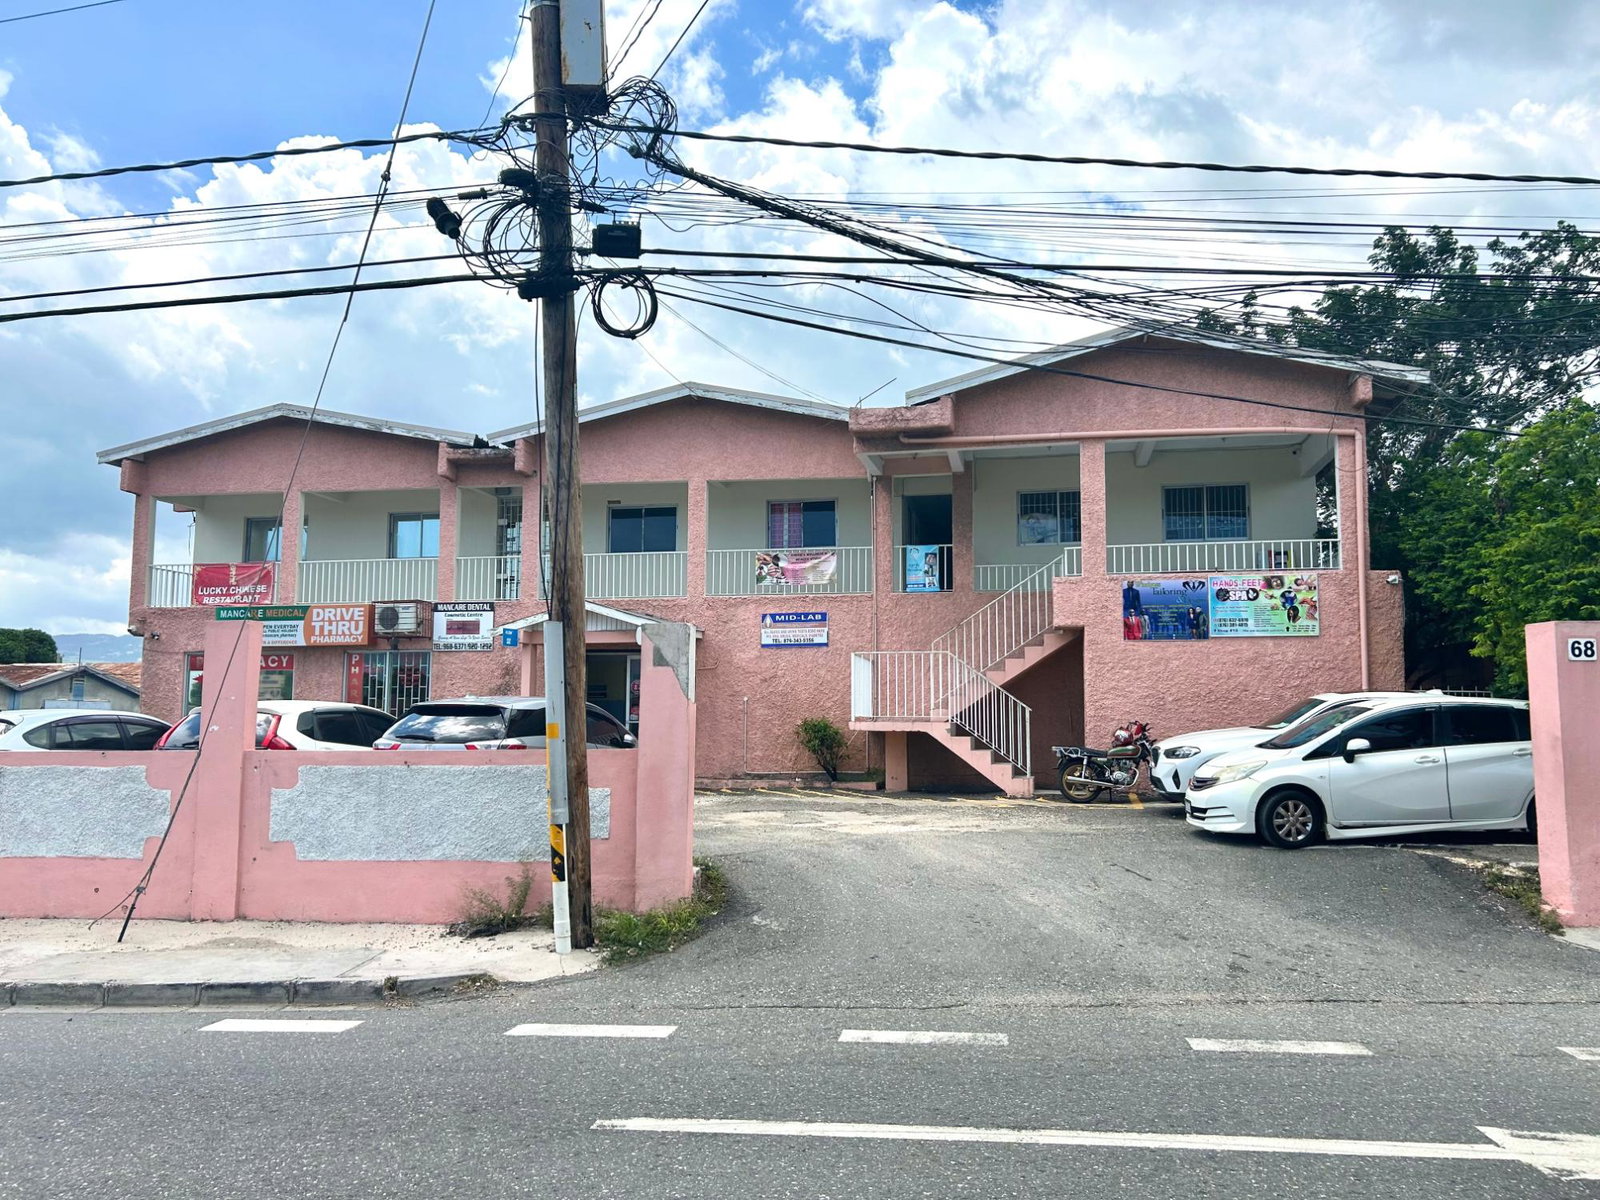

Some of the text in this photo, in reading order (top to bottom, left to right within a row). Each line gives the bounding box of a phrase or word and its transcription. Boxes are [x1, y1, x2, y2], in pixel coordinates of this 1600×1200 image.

[198, 586, 228, 594] LUCKY
[1230, 591, 1248, 600] SPA
[220, 608, 305, 619] MANCARE MEDICAL
[312, 607, 364, 621] DRIVE
[311, 621, 364, 635] THRU
[311, 635, 364, 643] PHARMACY
[1571, 640, 1595, 658] 68
[259, 655, 289, 667] ACY
